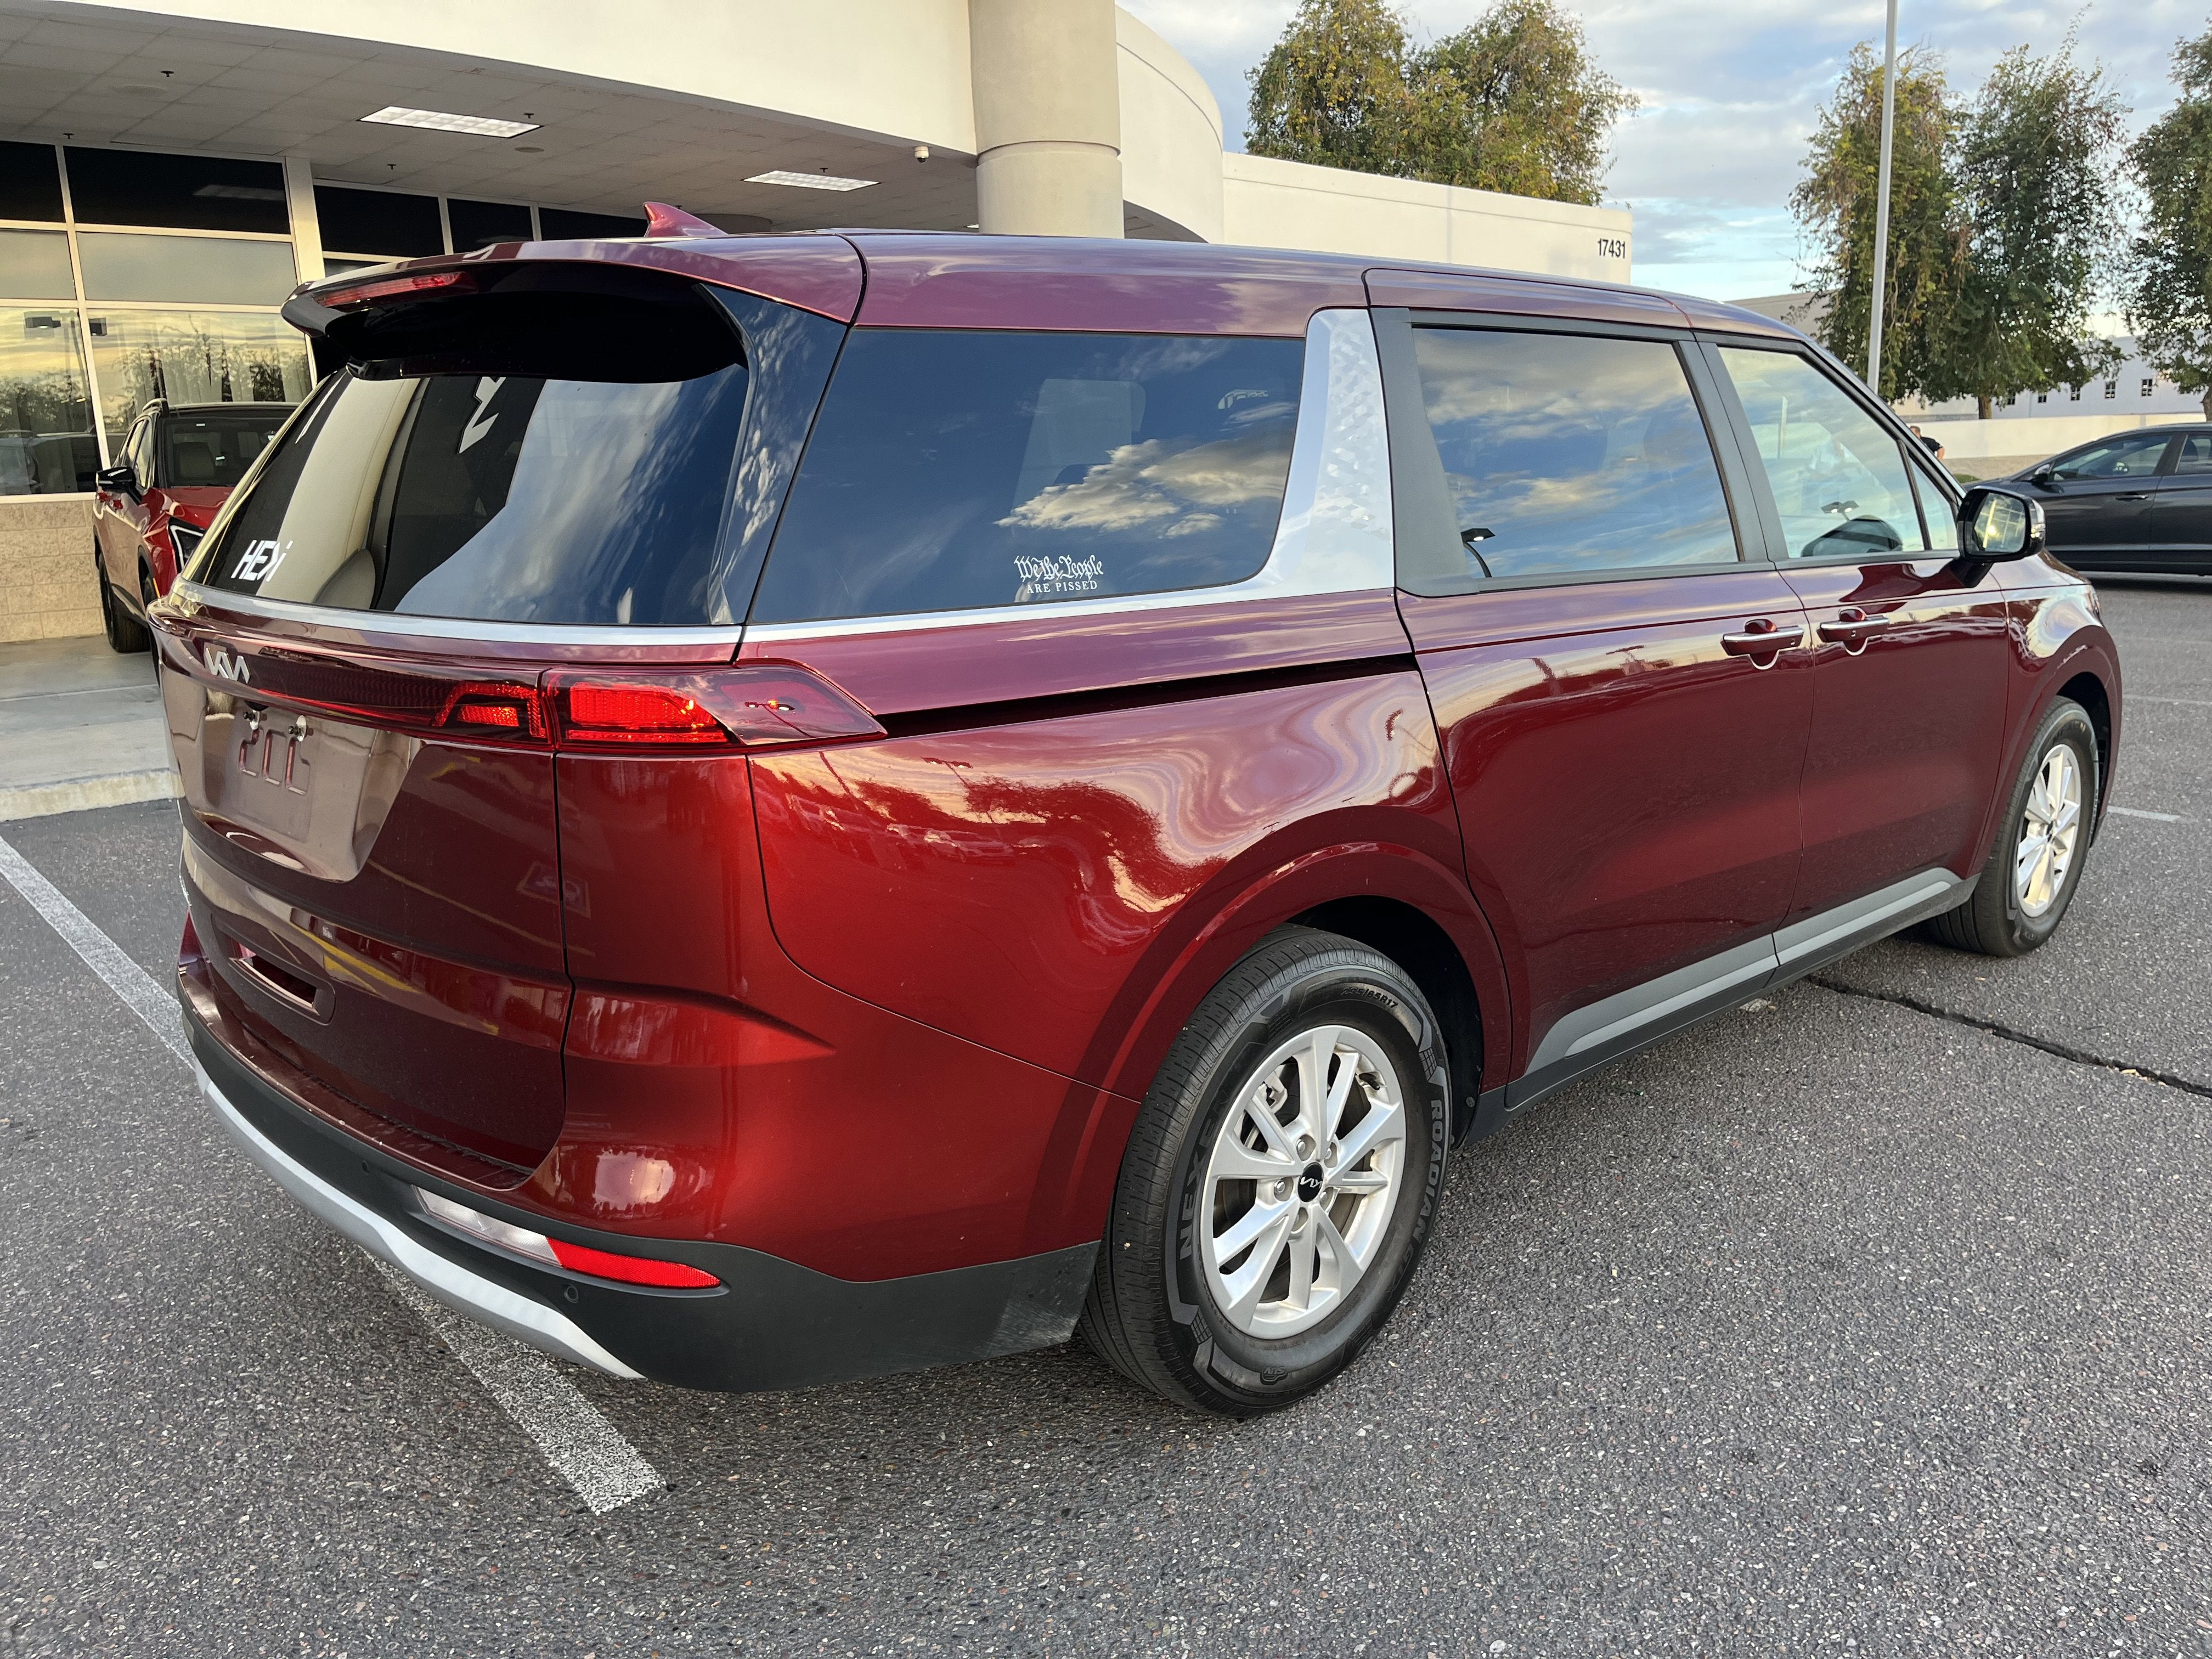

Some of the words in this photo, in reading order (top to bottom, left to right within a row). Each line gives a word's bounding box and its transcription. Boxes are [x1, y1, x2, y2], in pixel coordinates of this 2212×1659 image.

[1597, 238, 1626, 259] 17431
[1013, 556, 1043, 583] We
[1058, 555, 1104, 583] People
[1026, 583, 1051, 594] ARE
[1056, 580, 1097, 591] PISSED
[205, 647, 250, 684] KIA
[1413, 1099, 1443, 1244] ROADIAN
